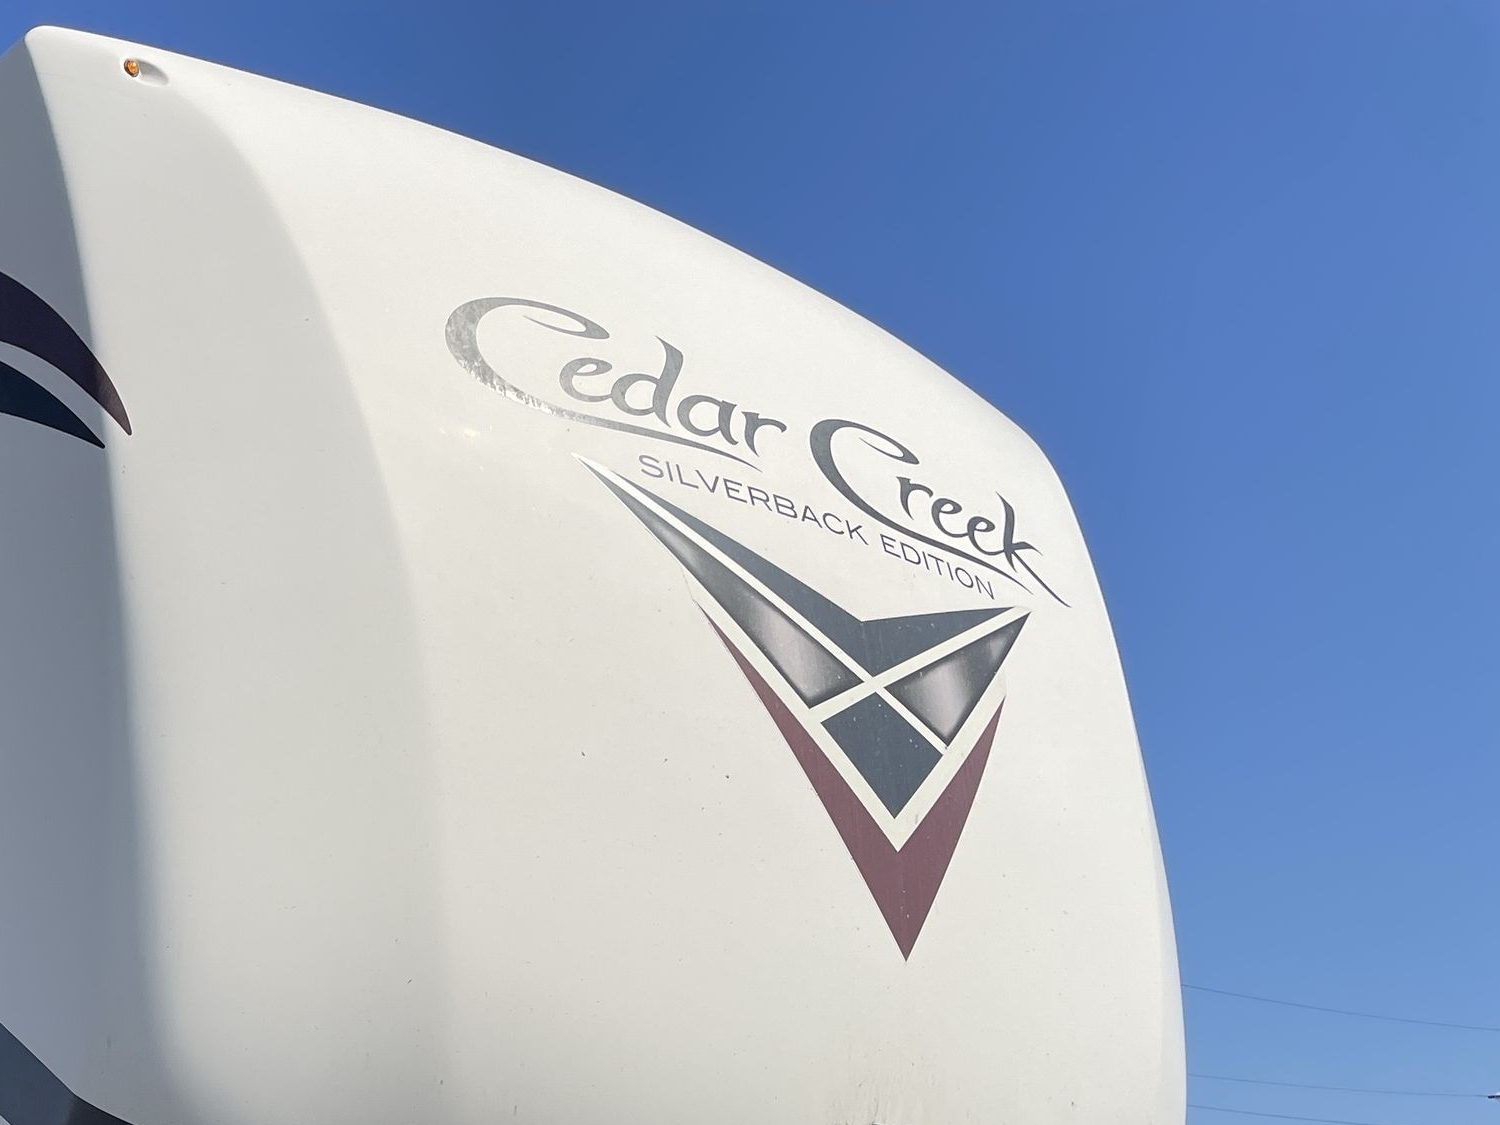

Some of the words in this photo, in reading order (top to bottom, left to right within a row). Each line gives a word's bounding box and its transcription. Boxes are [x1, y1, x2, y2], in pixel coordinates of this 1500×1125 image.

[445, 297, 787, 473] Cedar
[809, 418, 1072, 608] Creek
[638, 454, 869, 546] SILVERBACK
[880, 533, 995, 600] EDITION
